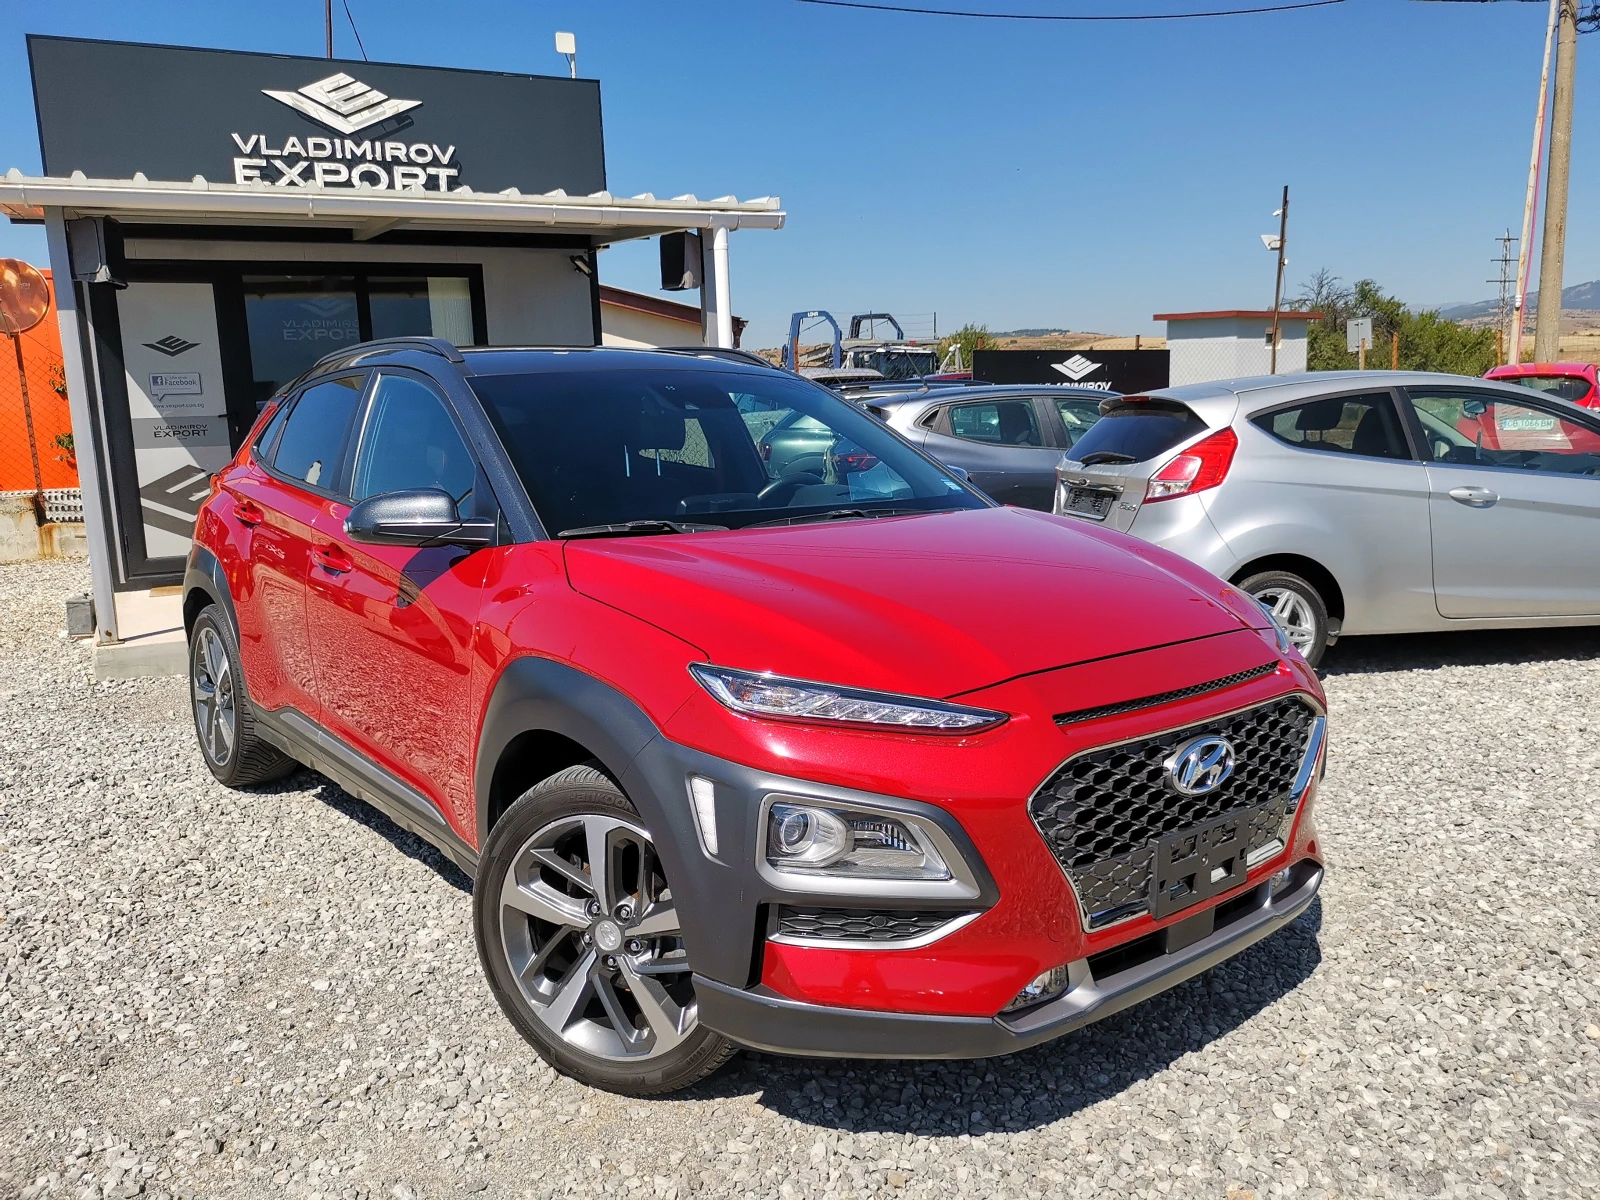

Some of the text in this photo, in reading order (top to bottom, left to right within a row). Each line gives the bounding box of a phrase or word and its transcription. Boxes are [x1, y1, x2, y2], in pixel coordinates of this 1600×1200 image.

[231, 133, 456, 165] VLADIMIROV
[233, 158, 459, 192] EXPORT
[153, 429, 209, 438] EXPORT
